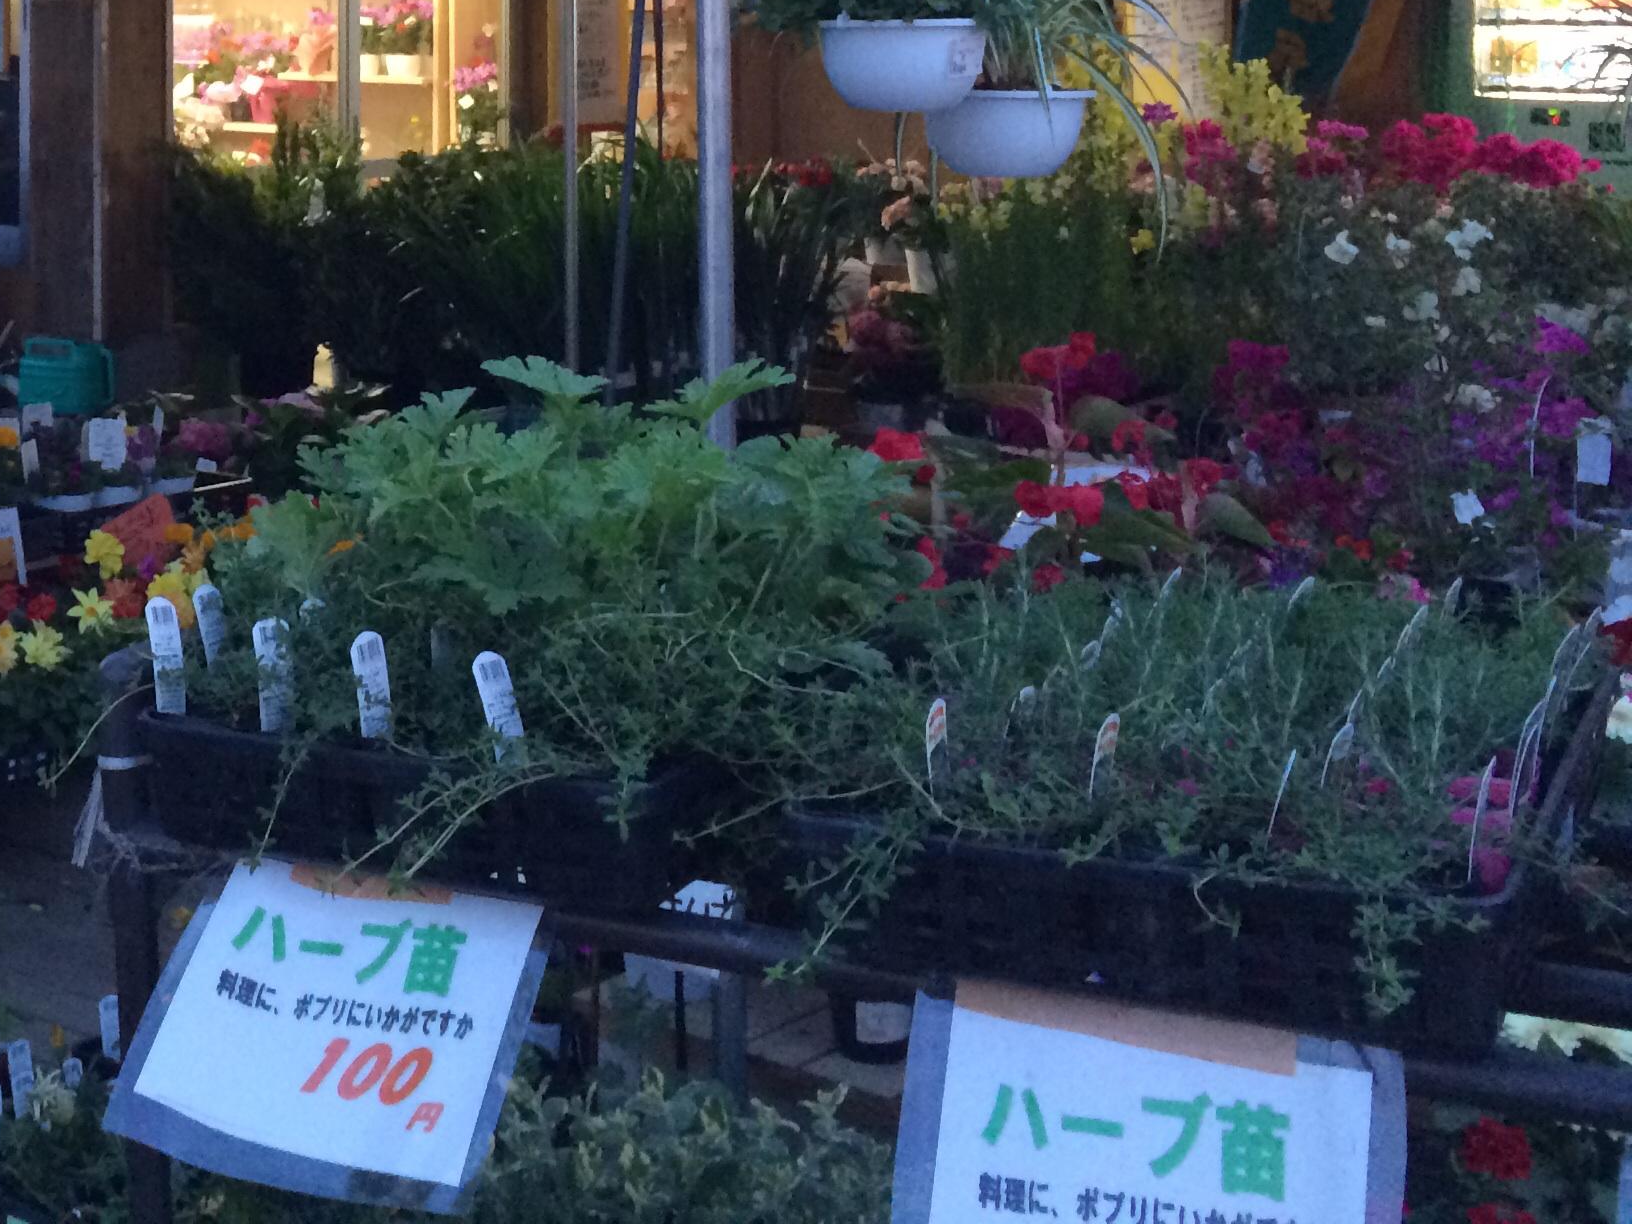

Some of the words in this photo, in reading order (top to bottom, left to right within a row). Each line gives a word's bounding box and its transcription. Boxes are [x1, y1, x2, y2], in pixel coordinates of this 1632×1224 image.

[230, 905, 468, 997] ハーブ苗
[980, 1082, 1292, 1202] ハーブ苗
